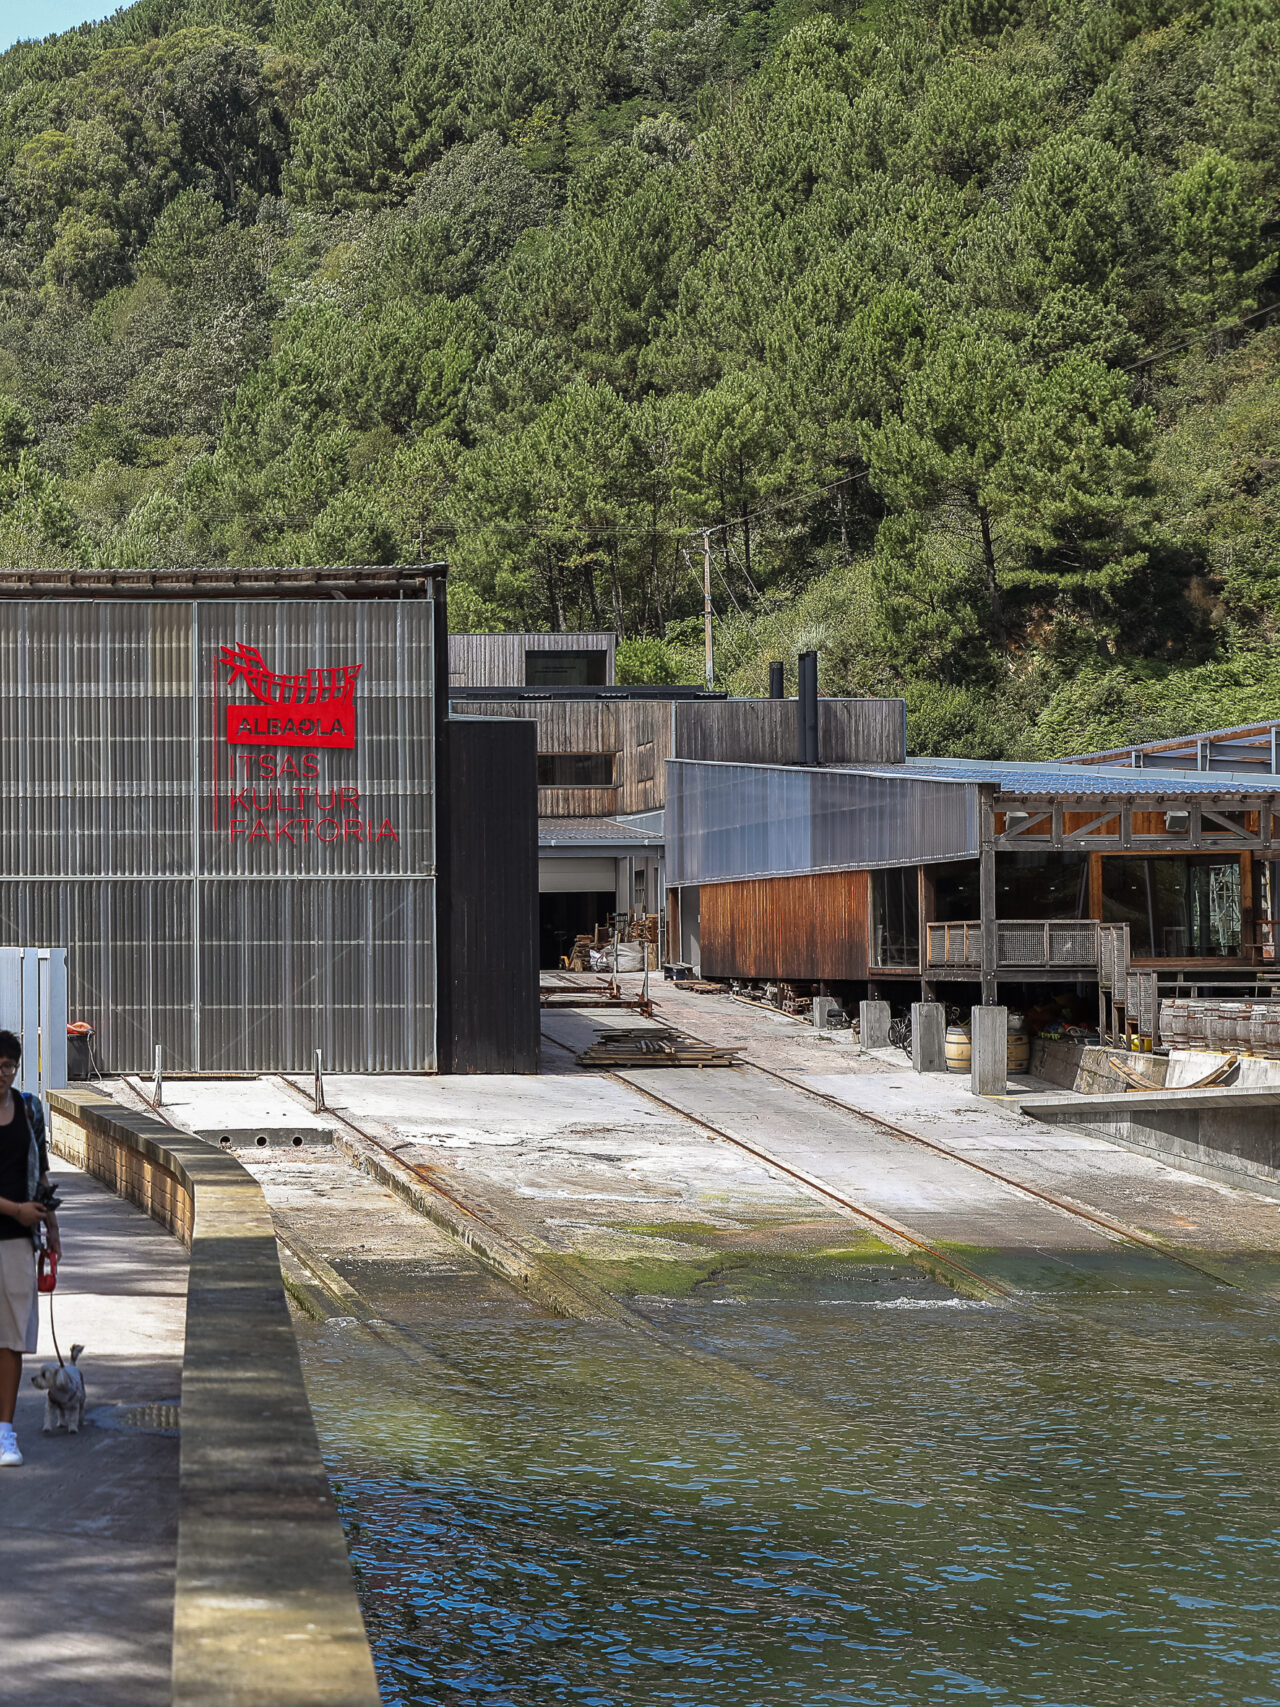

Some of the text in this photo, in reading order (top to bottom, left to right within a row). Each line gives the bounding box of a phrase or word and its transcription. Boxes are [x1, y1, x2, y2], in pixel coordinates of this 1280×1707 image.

[236, 717, 345, 736] ALBAOLA
[230, 753, 320, 778] ITSAS
[230, 786, 360, 811] KULTUR
[230, 817, 398, 843] FAKTORIA
